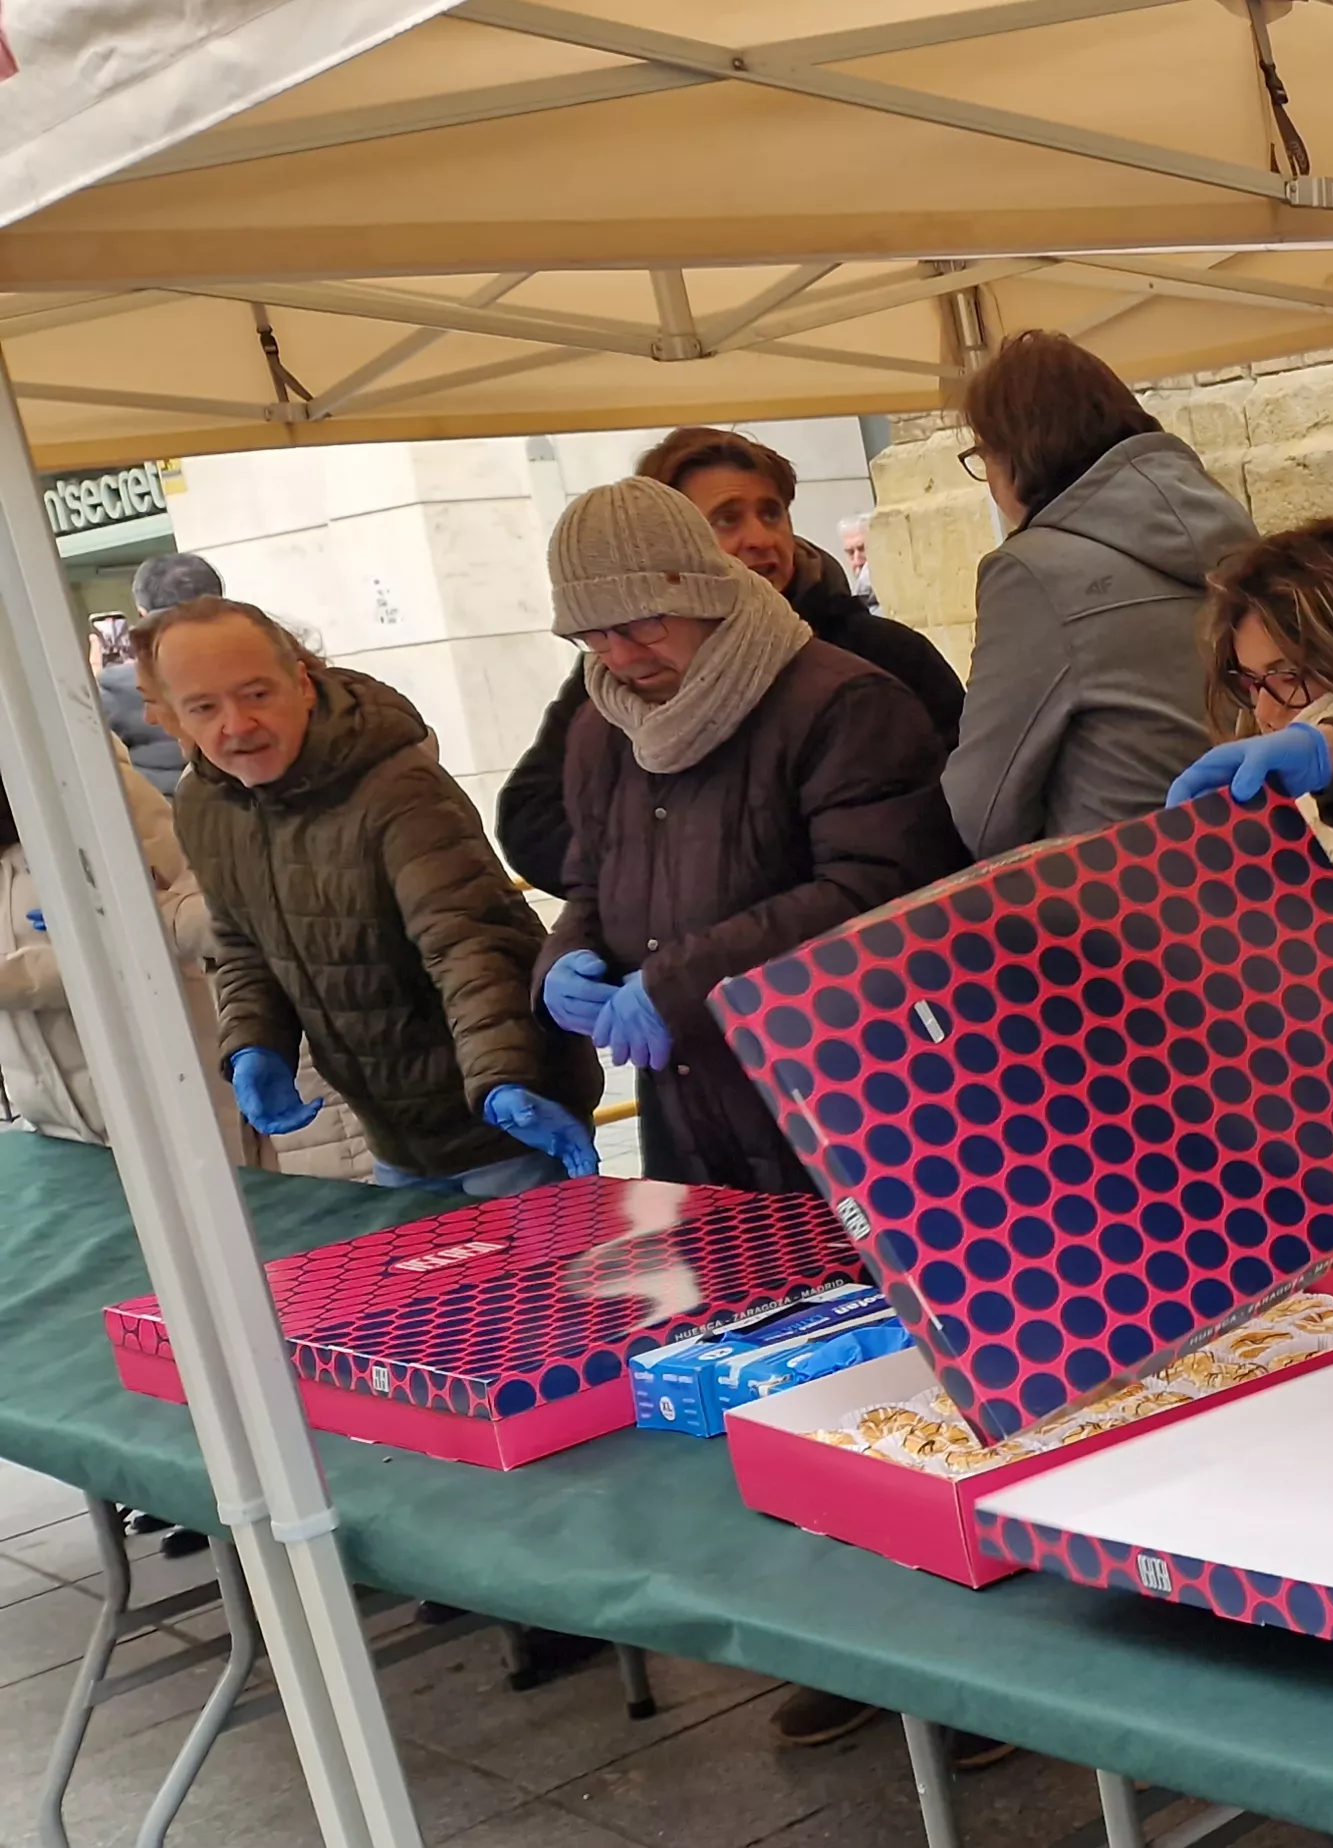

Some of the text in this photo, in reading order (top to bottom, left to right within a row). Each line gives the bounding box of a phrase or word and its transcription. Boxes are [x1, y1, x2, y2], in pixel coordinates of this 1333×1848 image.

[674, 1319, 723, 1342] HUESCA
[733, 1296, 791, 1322] ZARAGOZA
[800, 1278, 844, 1299] MADRID
